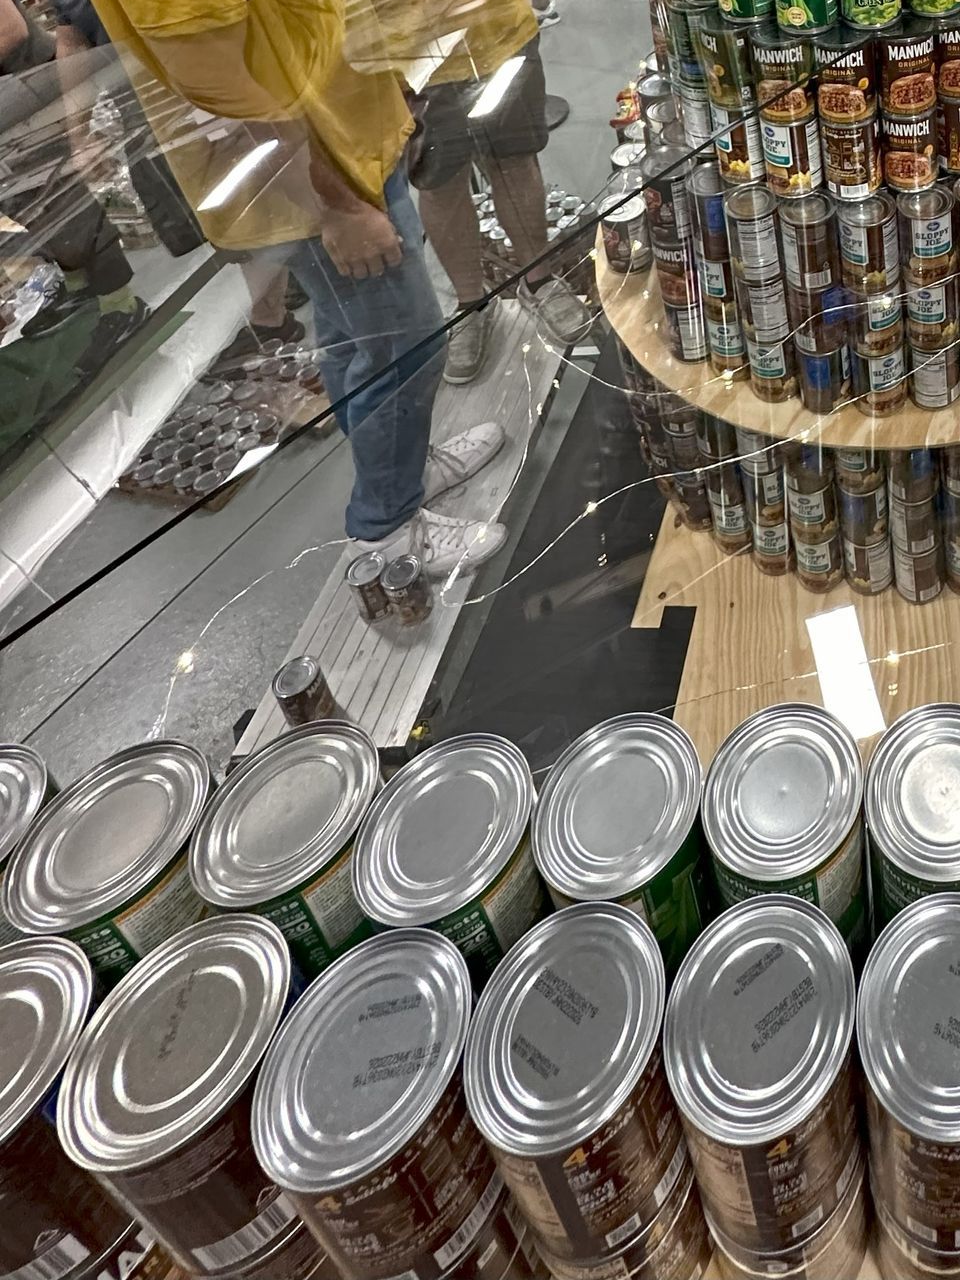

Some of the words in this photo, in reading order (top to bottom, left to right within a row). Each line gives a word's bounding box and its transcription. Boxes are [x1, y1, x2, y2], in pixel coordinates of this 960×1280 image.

[753, 45, 803, 63] MANWICH
[888, 36, 934, 61] MANWICH
[898, 56, 932, 68] ORIGINAL
[883, 120, 930, 136] MANWICH
[915, 228, 949, 240] SLOPPY
[925, 238, 941, 246] JOE
[910, 298, 942, 308] SLOPPY
[288, 920, 312, 938] 20
[463, 933, 488, 951] 20
[562, 1147, 587, 1168] 4
[766, 1139, 791, 1158] 4
